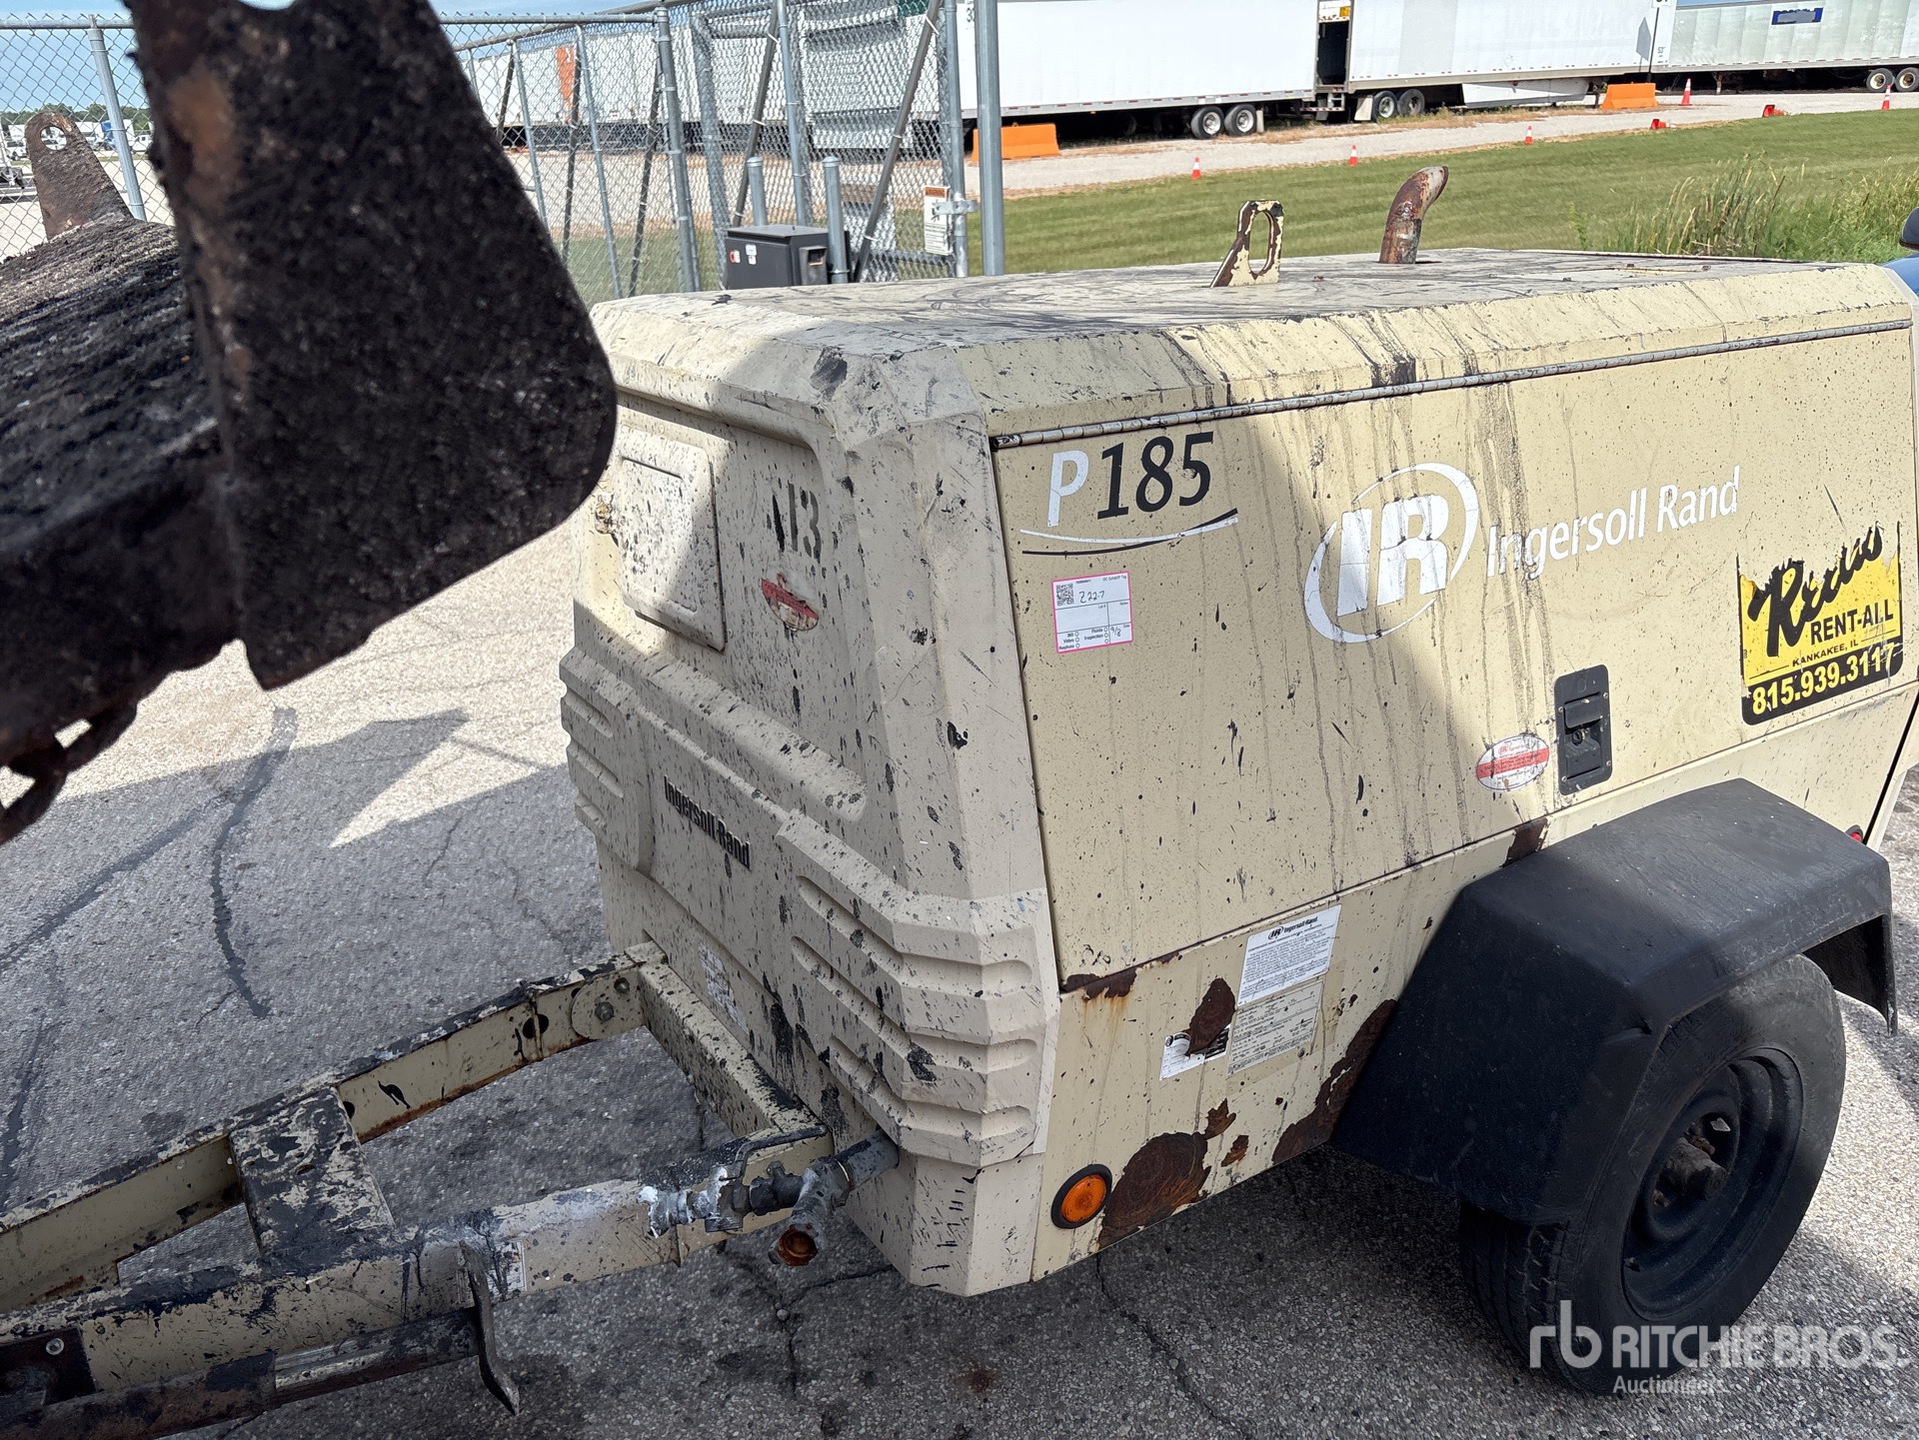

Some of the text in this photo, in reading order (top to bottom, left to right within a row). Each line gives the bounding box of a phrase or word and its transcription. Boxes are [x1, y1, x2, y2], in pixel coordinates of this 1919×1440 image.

[1337, 493, 1449, 617] IR
[1487, 465, 1740, 580] Ingersoll Rand
[1792, 638, 1859, 667] KANKAKEE, IL
[1811, 599, 1893, 645] RENT-ALL
[1752, 642, 1895, 715] 815.939.3117
